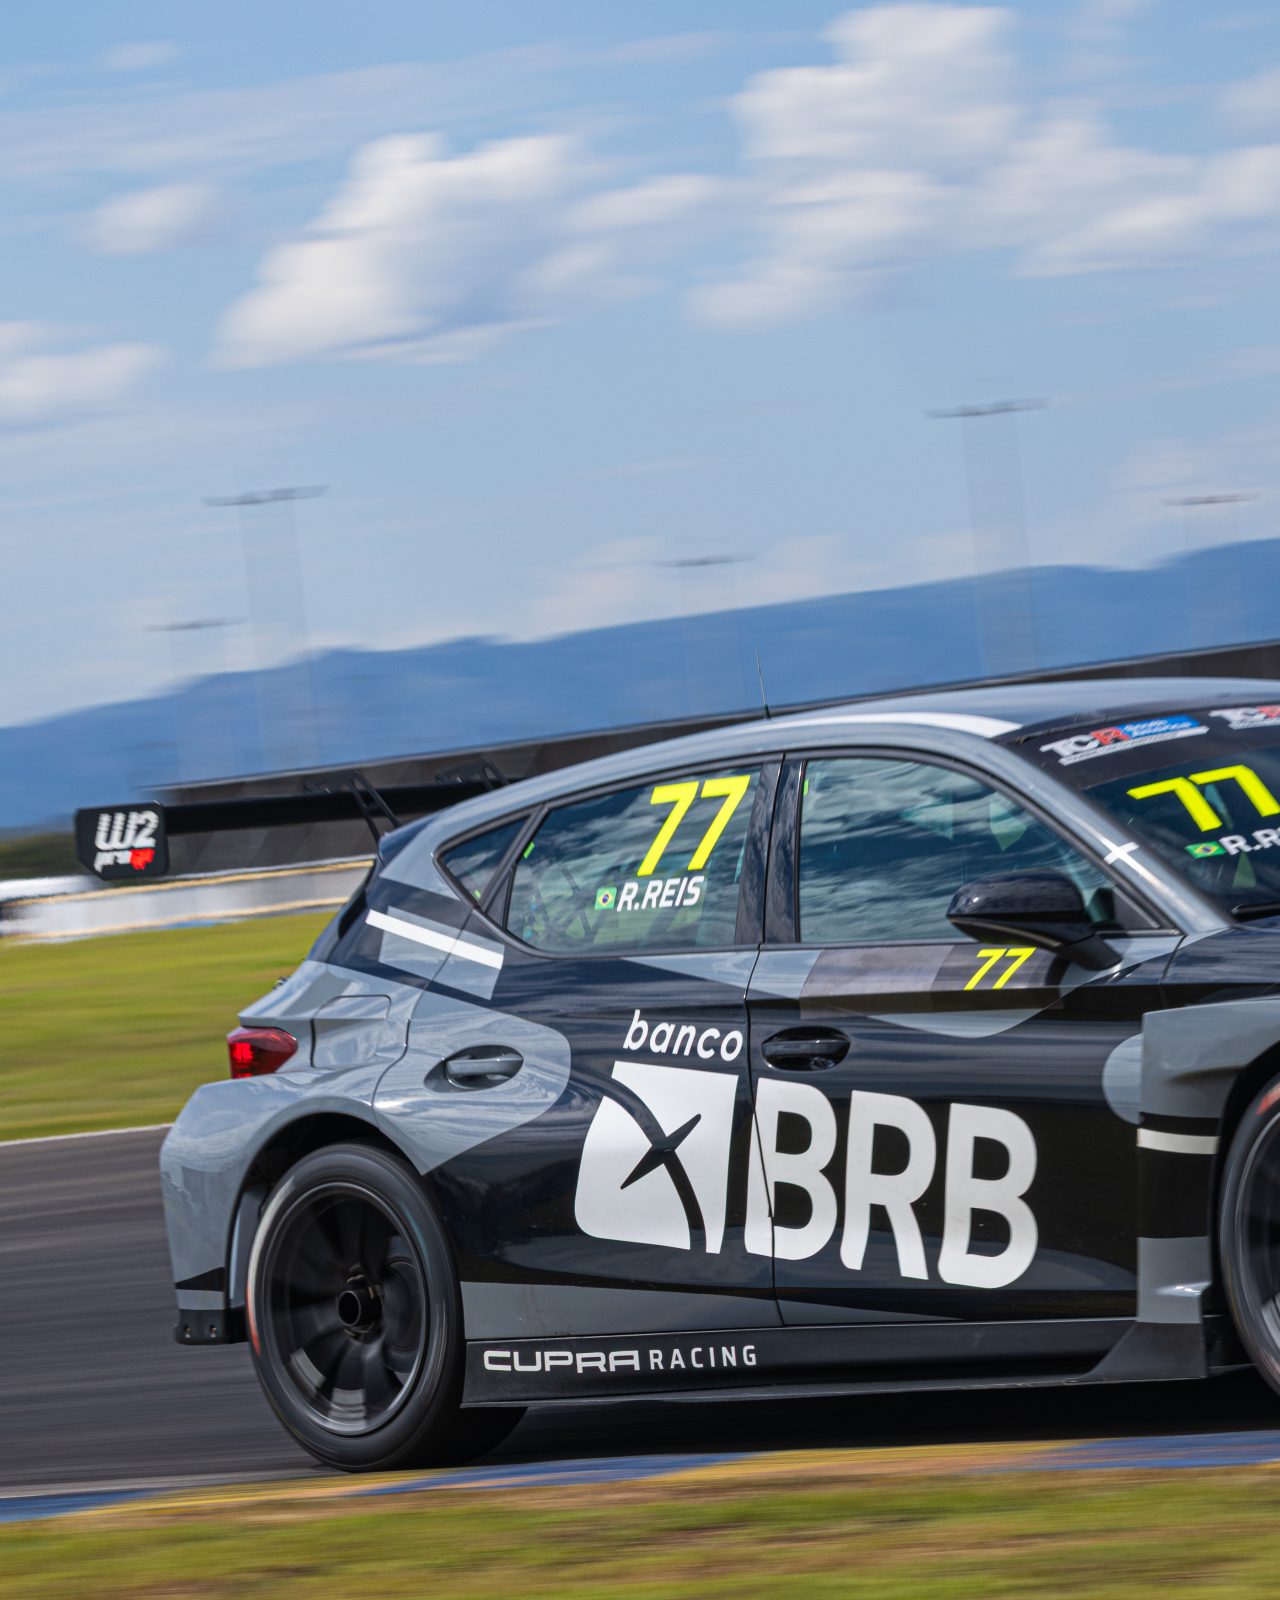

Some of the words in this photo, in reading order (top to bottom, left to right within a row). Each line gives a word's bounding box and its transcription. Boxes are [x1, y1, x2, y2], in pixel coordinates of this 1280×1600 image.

[1039, 727, 1131, 758] TCR
[95, 810, 159, 850] W2
[637, 775, 751, 877] 77
[617, 875, 705, 912] R.REIS
[963, 947, 1037, 991] 77
[622, 1008, 743, 1062] banco
[744, 1077, 1038, 1289] BRB
[483, 1350, 641, 1374] CUPRA
[649, 1345, 757, 1370] RACING
